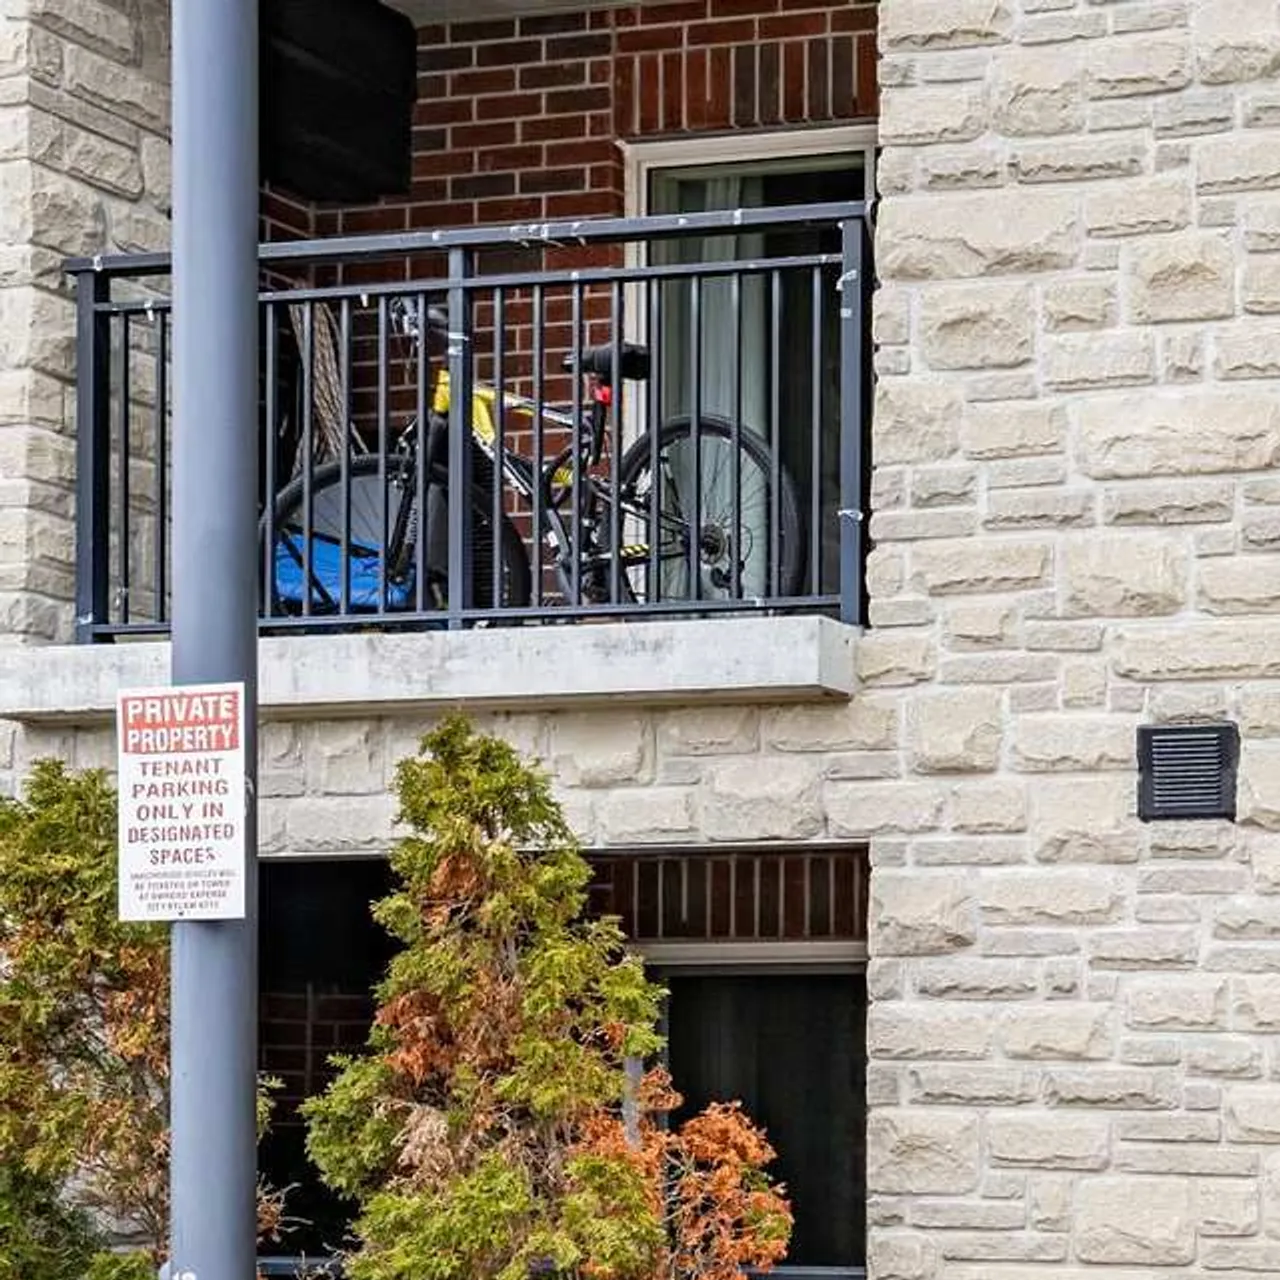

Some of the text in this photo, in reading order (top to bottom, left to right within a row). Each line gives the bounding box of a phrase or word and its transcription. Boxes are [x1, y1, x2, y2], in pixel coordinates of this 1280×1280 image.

[127, 695, 234, 723] PRIVATE
[127, 724, 234, 752] PROPERTY
[139, 758, 223, 777] TENANT
[132, 779, 229, 799] PARKING
[136, 802, 223, 821] ONLY IN
[128, 824, 234, 844] DESIGNATED
[150, 847, 216, 865] SPACES
